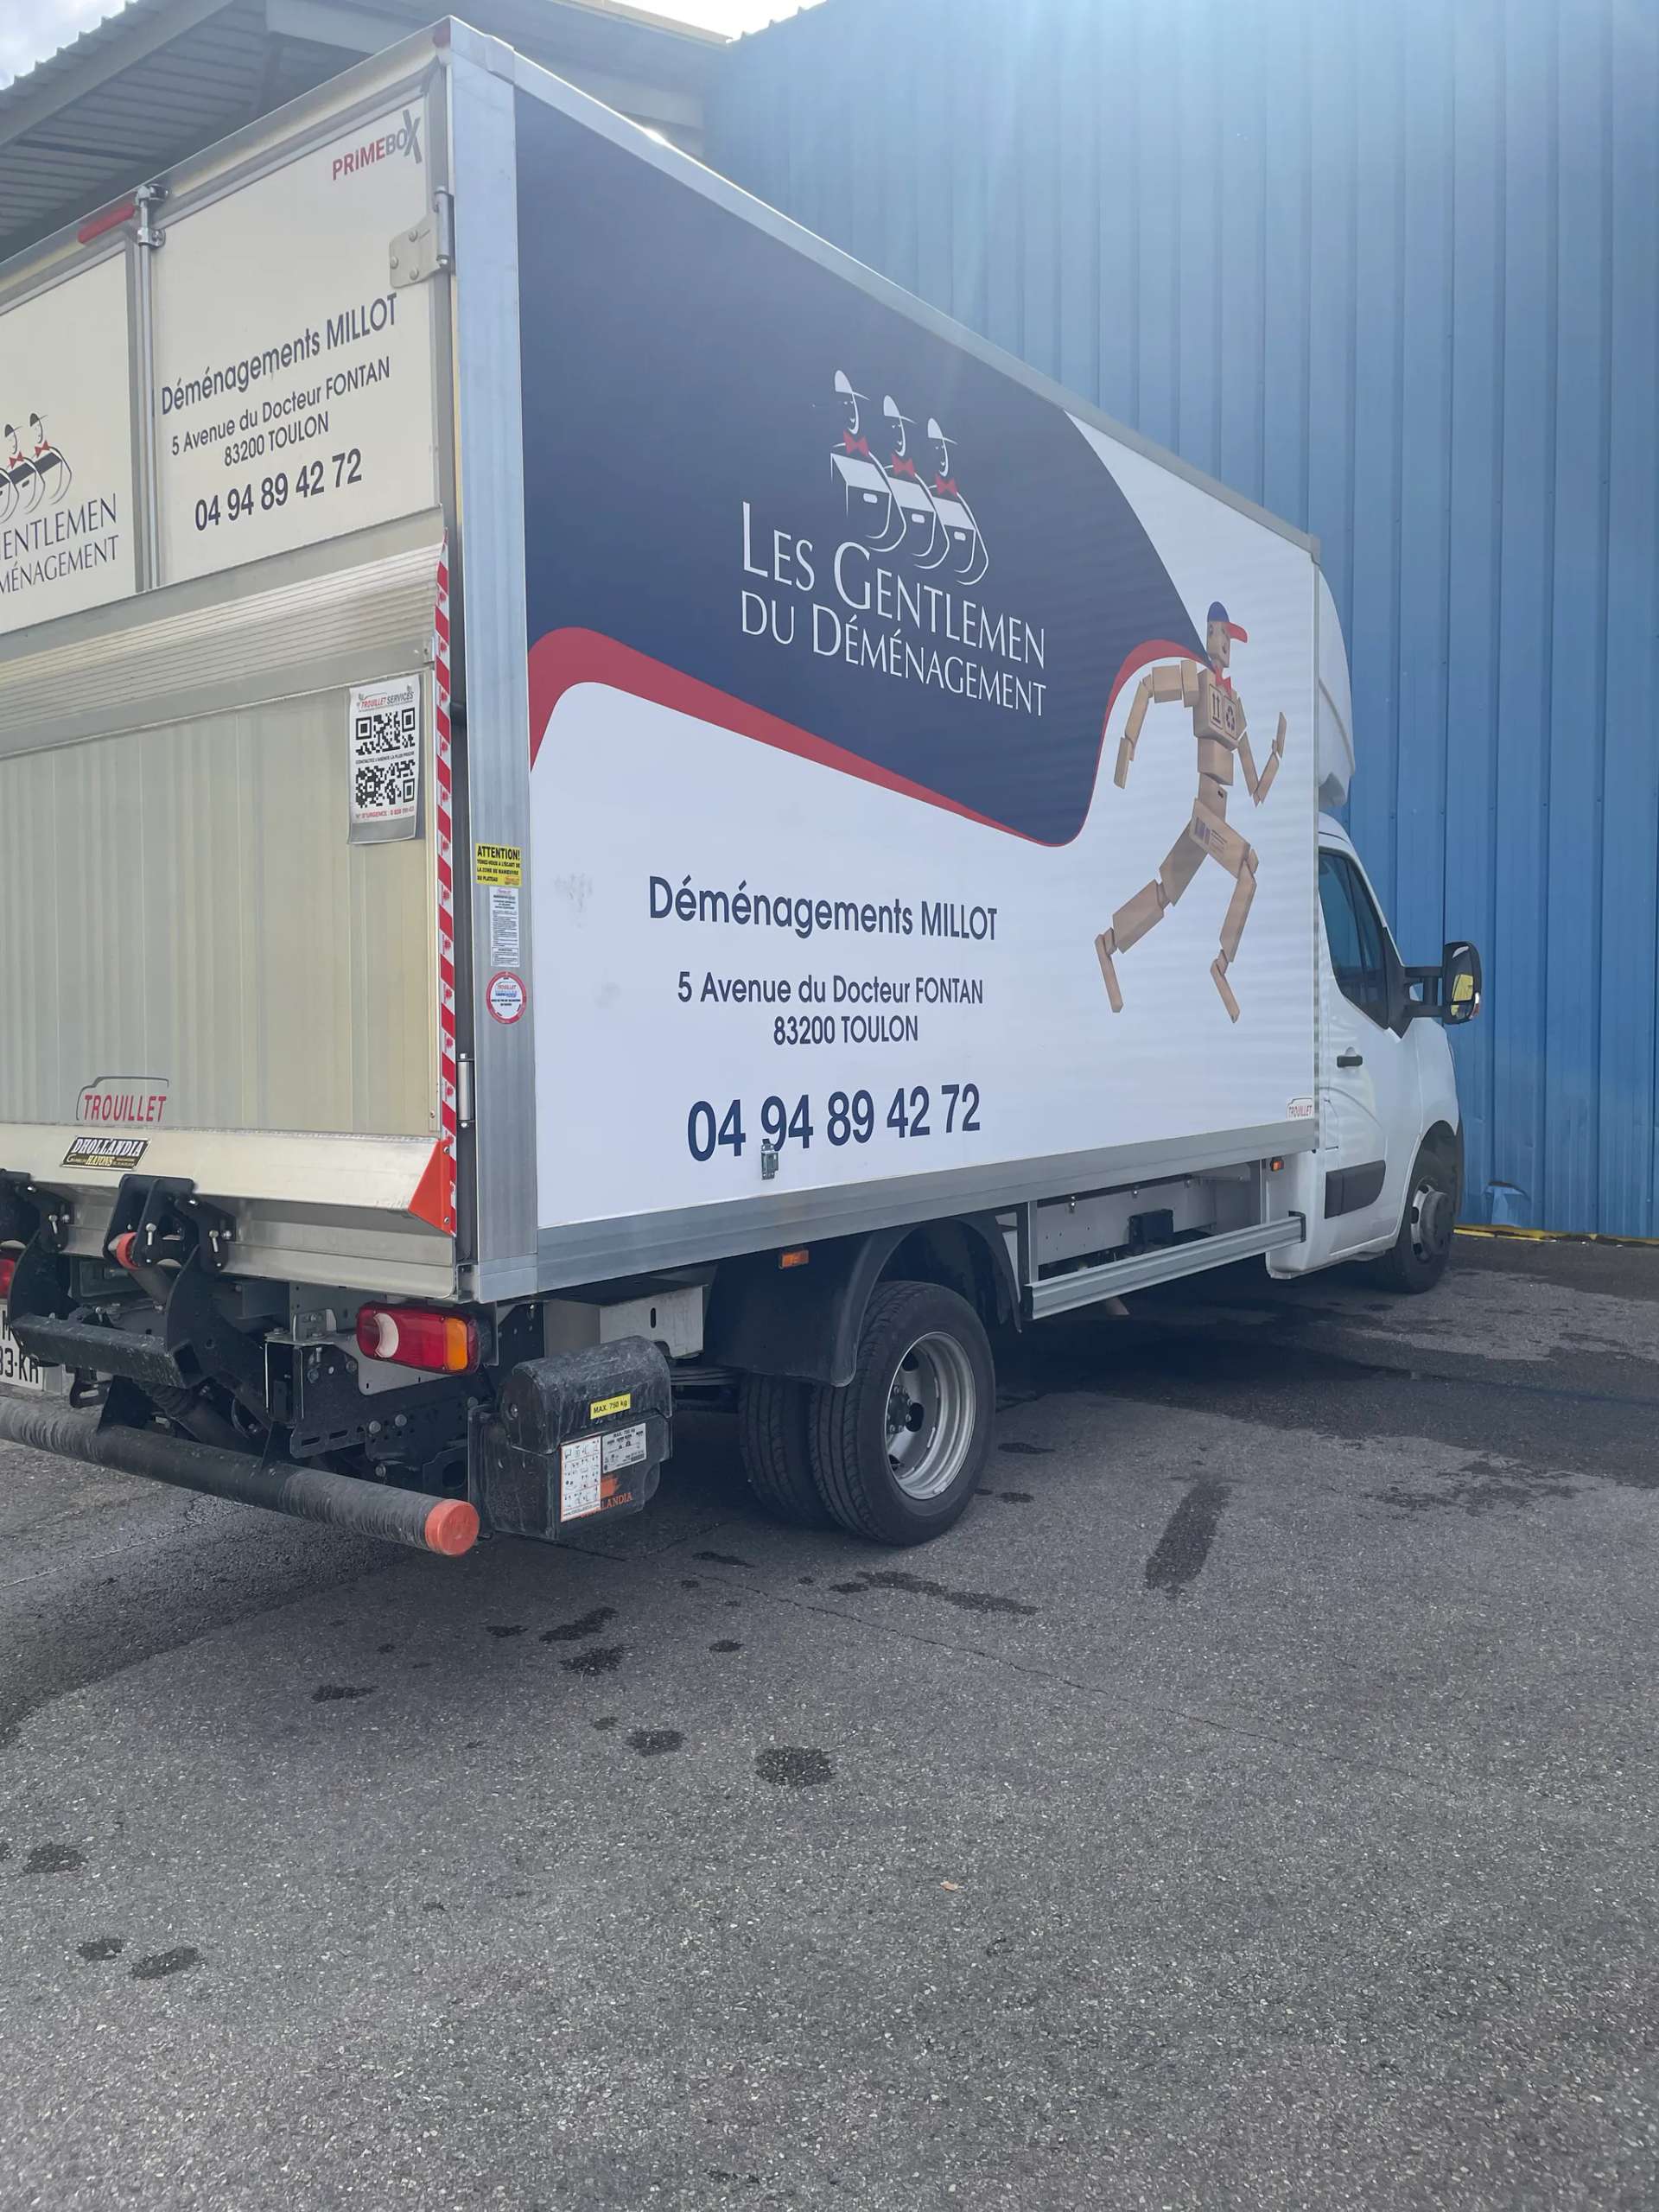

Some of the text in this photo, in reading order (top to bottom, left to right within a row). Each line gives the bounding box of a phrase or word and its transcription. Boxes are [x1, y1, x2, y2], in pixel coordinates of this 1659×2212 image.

[162, 294, 397, 415] Déménagements MILLOT
[172, 357, 391, 455] 5 Avenue du Docteur FONTAN
[224, 411, 329, 467] 83200 TOULON
[195, 448, 362, 531] 04 94 89 42 72
[3, 493, 117, 560] ENTLEMEN
[742, 500, 1046, 670] LES GENTLEMEN
[741, 590, 1046, 717] DU DÉMÉNAGEMENT
[361, 696, 386, 709] TROUILLET
[386, 691, 415, 705] SERVICES
[477, 845, 520, 861] ATTENTION!
[650, 874, 997, 940] Déménagements MILLOT
[677, 971, 983, 1004] 5 Avenue du Docteur FONTAN
[773, 1015, 918, 1045] 83200 TOULON
[85, 1094, 167, 1122] TROUILLET
[688, 1083, 981, 1161] 04 94 89 42 72
[71, 1139, 144, 1156] DHOLLANDIA
